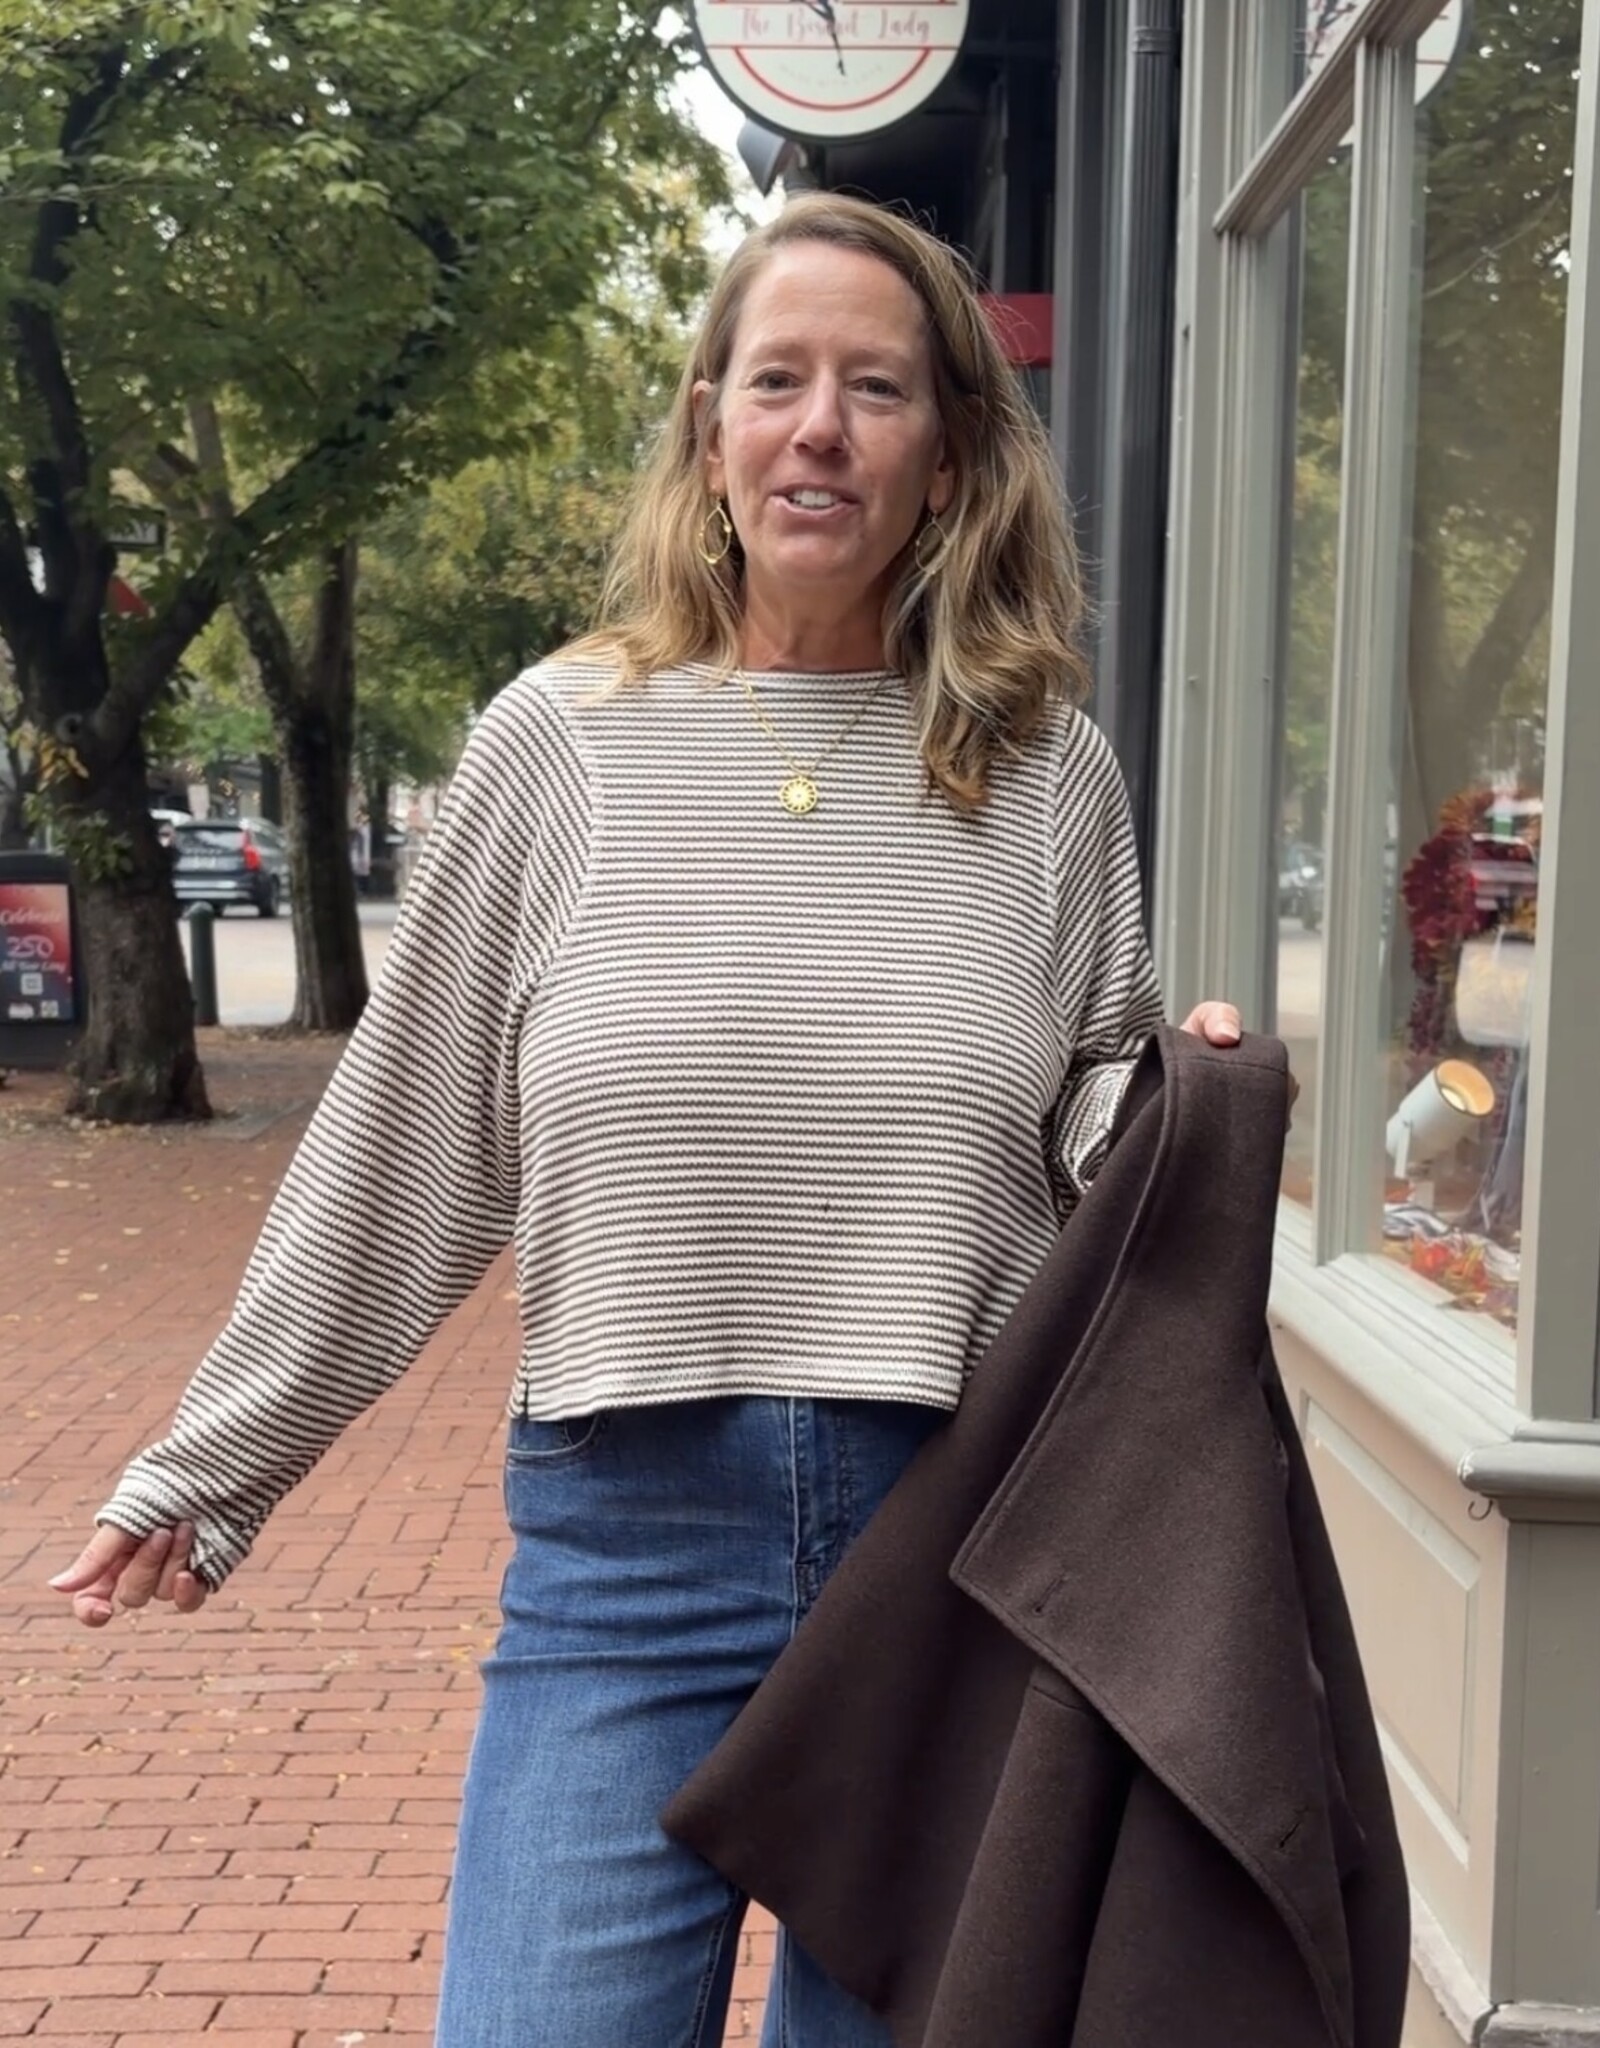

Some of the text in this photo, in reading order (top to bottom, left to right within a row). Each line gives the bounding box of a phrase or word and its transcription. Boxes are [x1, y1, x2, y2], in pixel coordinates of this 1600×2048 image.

[742, 8, 770, 39] The
[878, 8, 930, 42] Lady
[7, 934, 55, 958] 250
